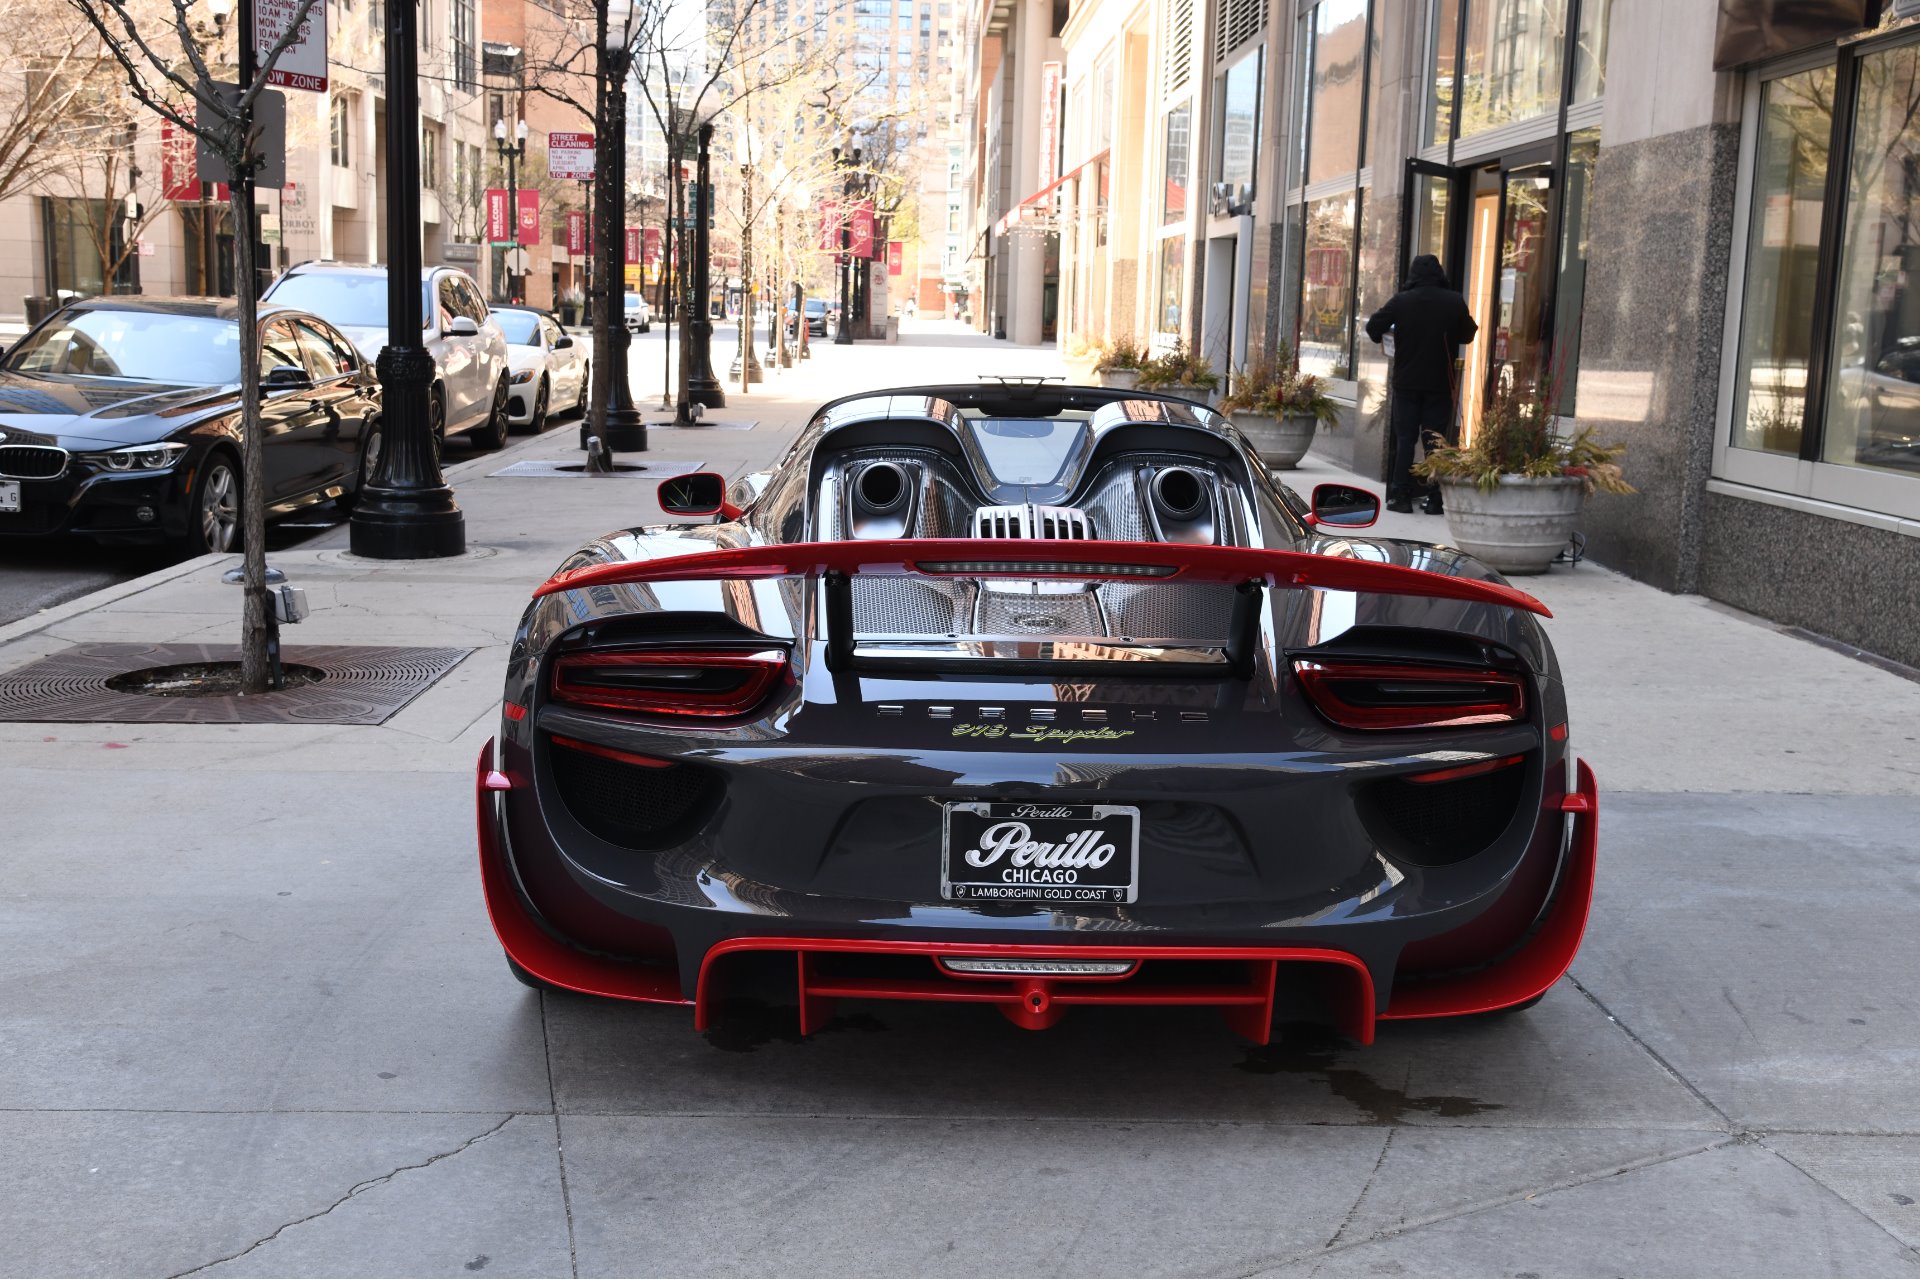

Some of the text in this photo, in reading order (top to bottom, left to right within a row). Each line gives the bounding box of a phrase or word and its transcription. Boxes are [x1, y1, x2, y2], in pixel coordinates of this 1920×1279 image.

[259, 6, 267, 16] 10
[268, 8, 281, 18] AM
[297, 1, 323, 16] LHTS
[259, 17, 276, 29] MON
[259, 28, 267, 38] 10
[268, 30, 280, 40] AM
[258, 40, 272, 49] FRI
[267, 71, 322, 90] OW ZONE
[282, 219, 316, 228] ORBOY
[492, 195, 500, 238] WELCOME
[877, 704, 1210, 722] PORSCHE
[951, 723, 1135, 744] 918 Spyder
[1011, 804, 1073, 819] Perillo
[965, 821, 1116, 870] Perillo
[1002, 868, 1078, 884] CHICAGO
[971, 888, 1107, 900] LAMBORGHINI GOLD COAST
